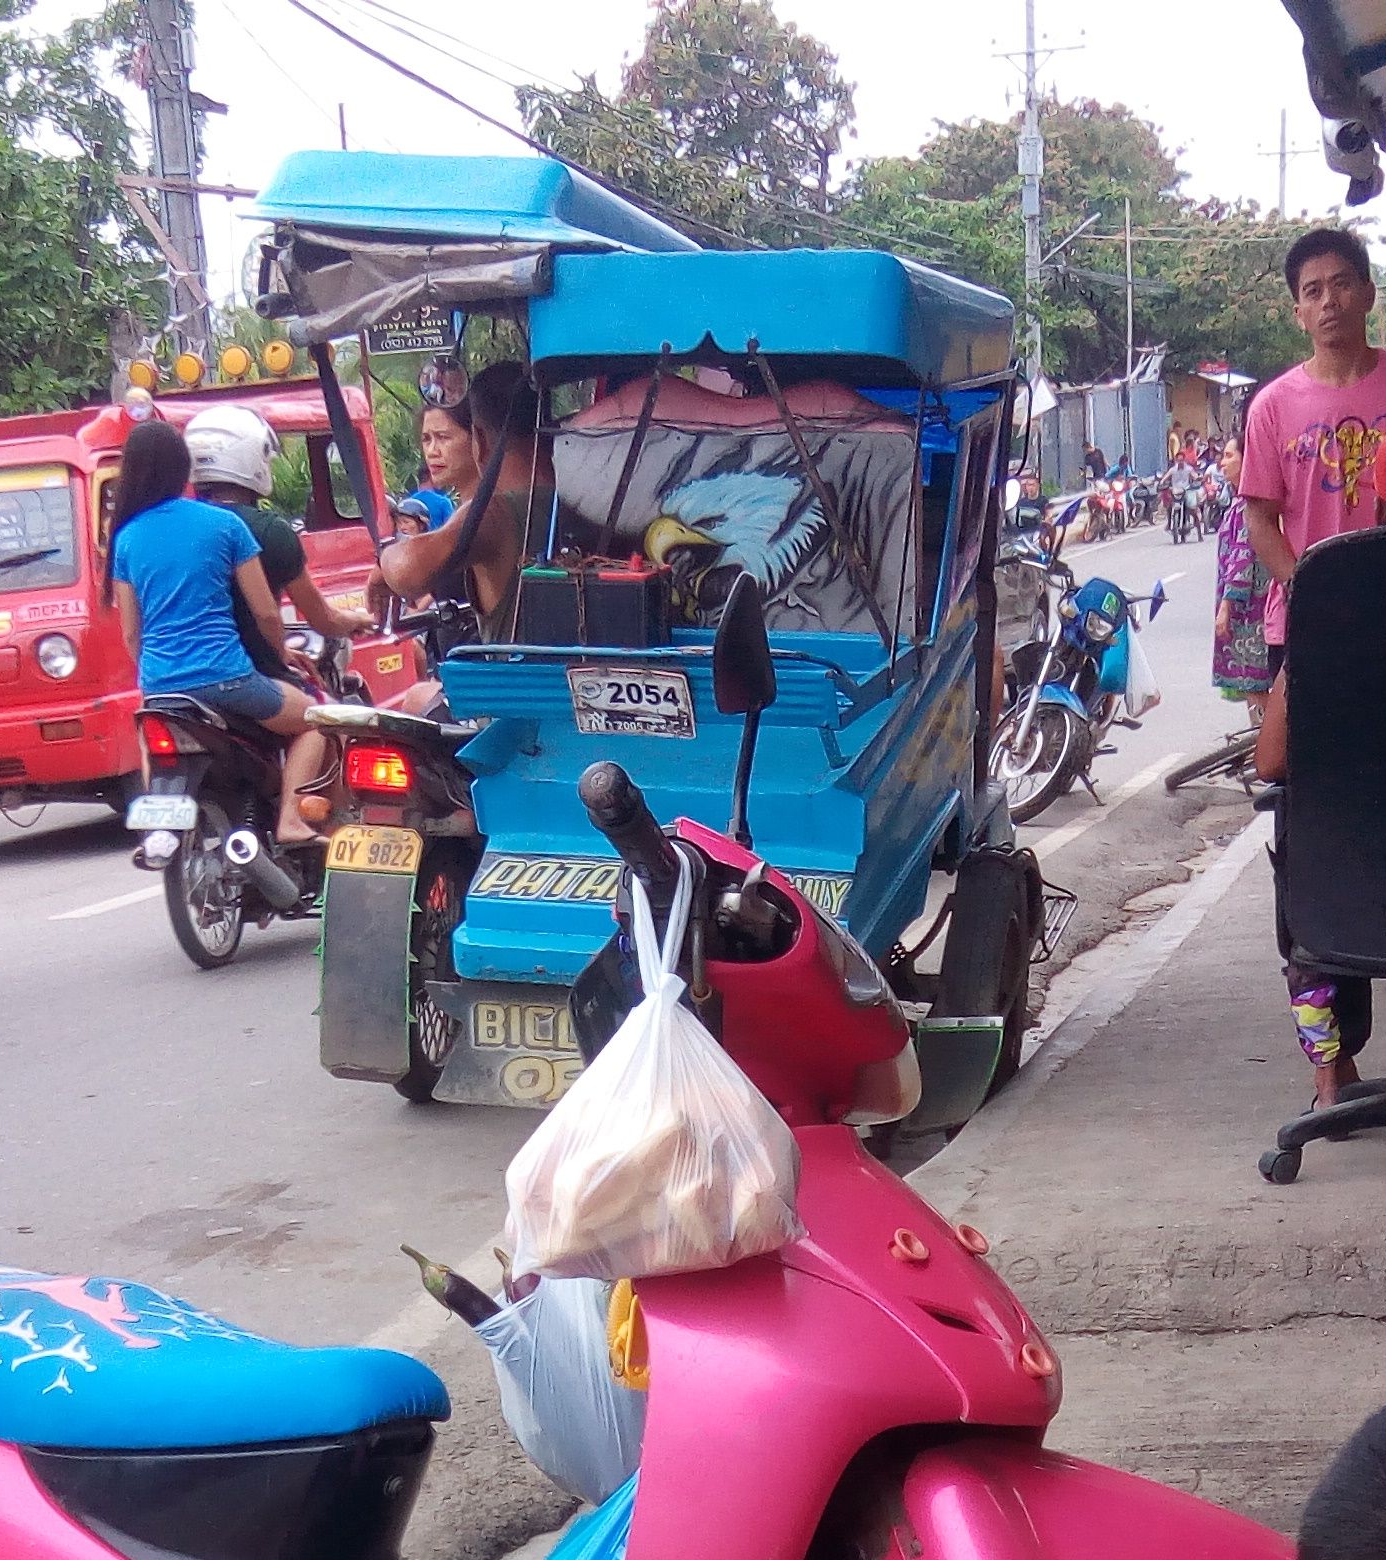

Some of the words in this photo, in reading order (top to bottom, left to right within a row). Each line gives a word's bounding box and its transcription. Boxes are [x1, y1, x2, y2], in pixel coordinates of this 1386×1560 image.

[607, 682, 680, 707] 2054
[335, 840, 362, 863] QY
[367, 842, 414, 867] 9822
[474, 860, 620, 899] PATA
